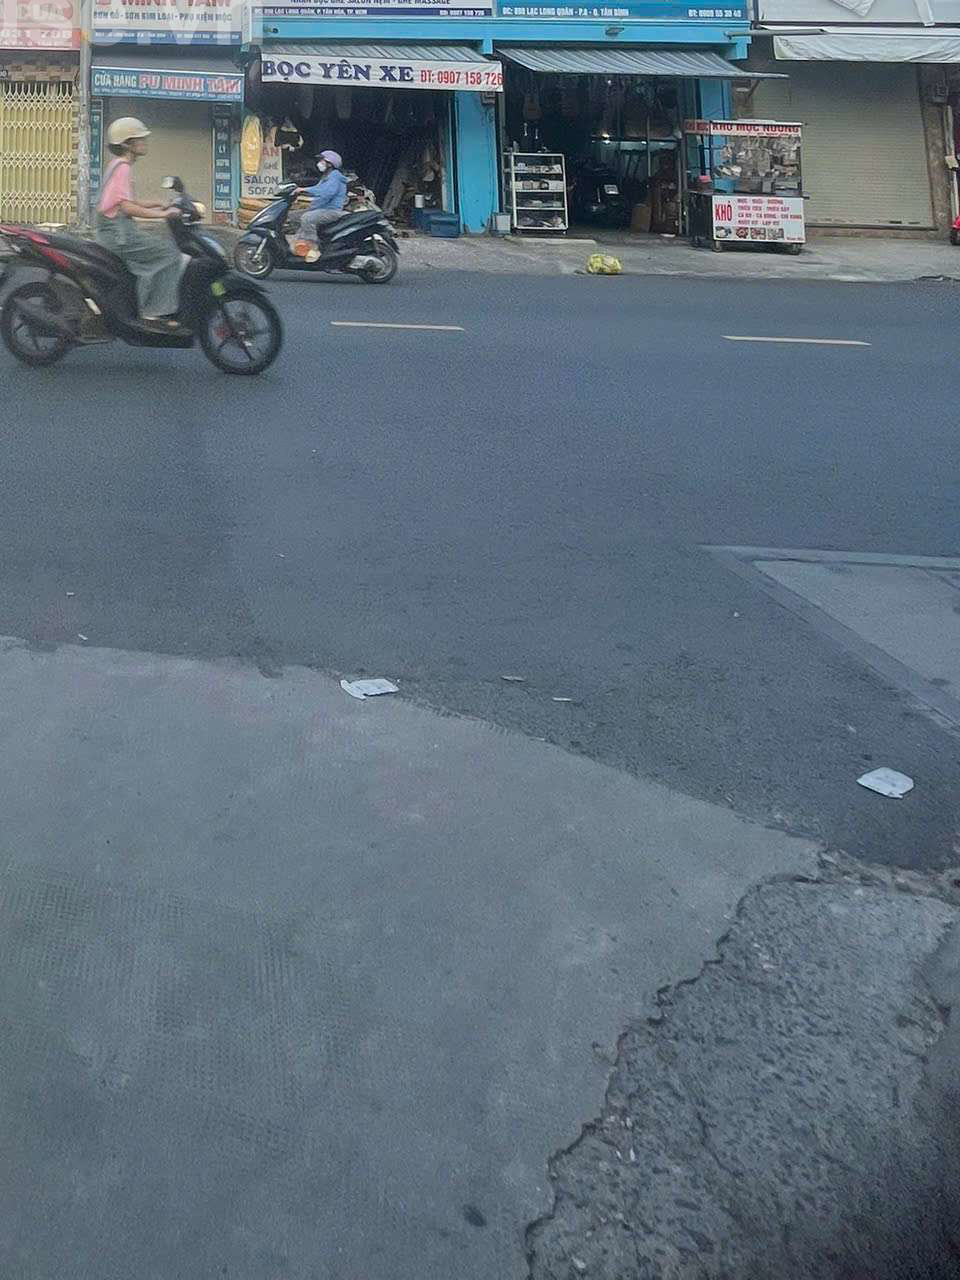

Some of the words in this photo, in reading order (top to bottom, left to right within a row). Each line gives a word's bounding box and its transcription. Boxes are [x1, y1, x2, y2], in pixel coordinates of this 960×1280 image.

[262, 60, 312, 81] BỌC
[318, 59, 372, 81] YÊN
[379, 65, 414, 82] XE
[437, 71, 461, 84] 0907
[465, 71, 481, 85] 158
[485, 72, 503, 86] 726
[244, 175, 280, 185] SALON
[248, 186, 274, 196] SOFA
